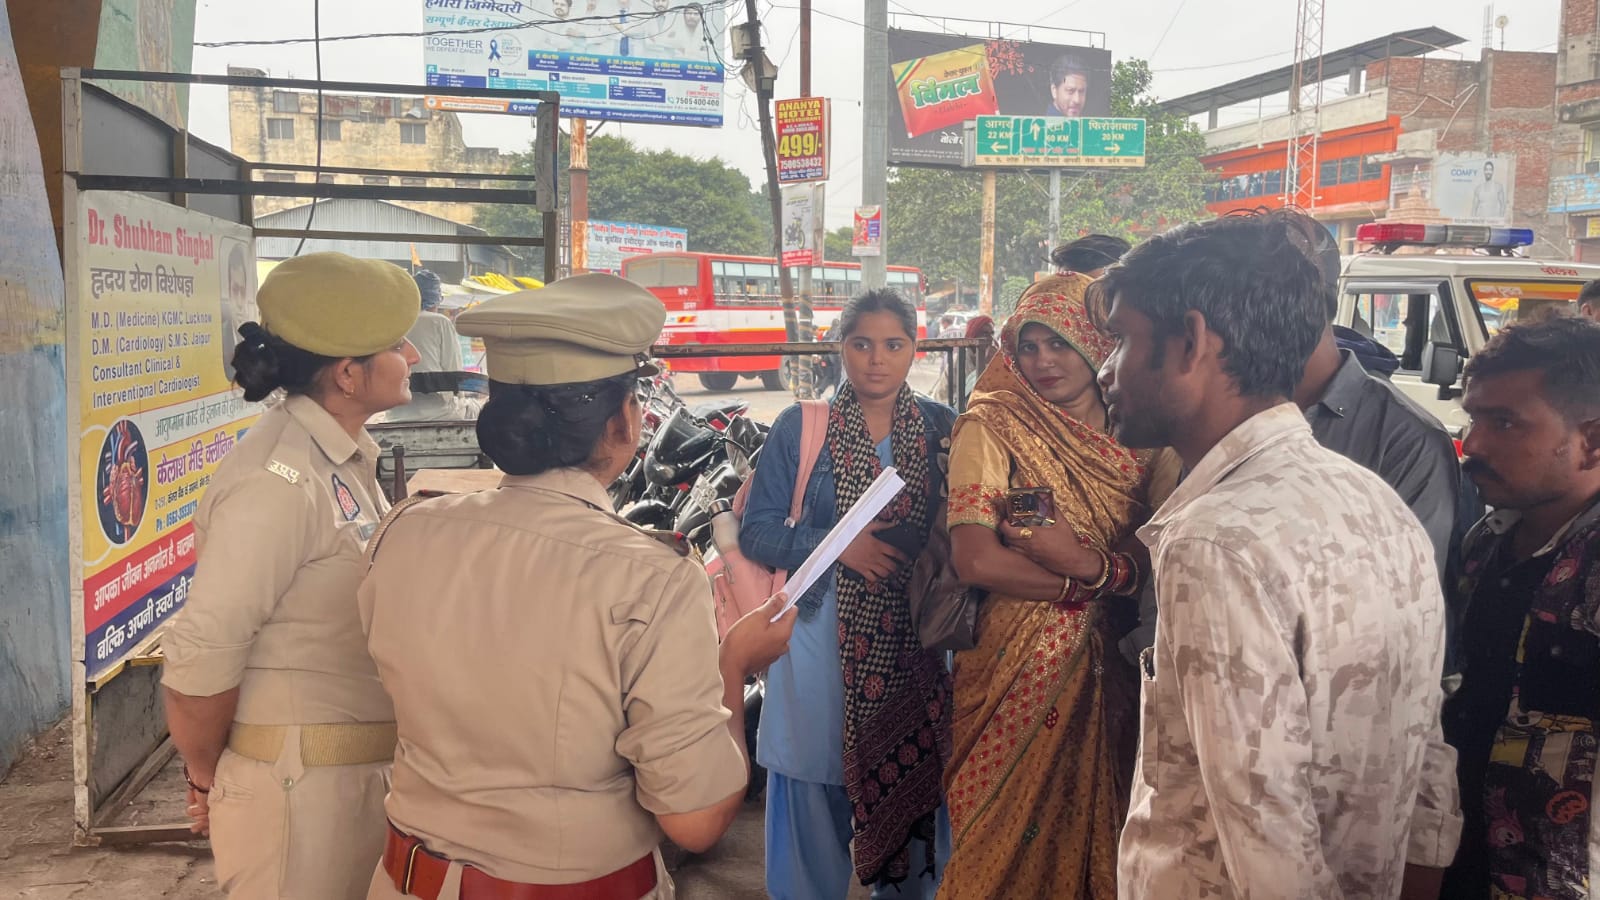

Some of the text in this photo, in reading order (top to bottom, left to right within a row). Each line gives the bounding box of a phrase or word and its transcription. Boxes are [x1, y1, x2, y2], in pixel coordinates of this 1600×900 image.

[426, 37, 483, 49] TOGETHER
[779, 100, 821, 111] ANANYA
[779, 108, 821, 119] HOTEL
[999, 131, 1012, 139] KM
[1057, 134, 1069, 143] KM
[1088, 120, 1138, 132] फिरोजाबाद
[1112, 133, 1124, 141] KM
[779, 132, 822, 158] 499/-
[1450, 168, 1478, 177] COMFY
[88, 208, 214, 266] Dr. Shubham Singhal
[129, 263, 152, 292] रोग
[155, 264, 194, 298] विशेषज्ञ
[92, 310, 212, 330] M.D. (Medicine) KGMC Lucknow
[92, 331, 211, 356] D.M. (Cardiology) S.M.S. Jaipur
[92, 354, 181, 382] Consultant Clinical &
[93, 374, 201, 408] Interventional Cardiologist
[155, 412, 185, 442] आयुष्मान
[157, 453, 187, 485] कैलाश
[206, 431, 234, 464] क्लीनिक
[94, 576, 121, 611] आपका
[121, 562, 143, 591] जीवन
[144, 545, 168, 579] अनमोल
[168, 538, 176, 566] है,
[97, 624, 126, 660] बल्कि
[127, 598, 154, 639] अपनी
[155, 583, 174, 618] स्वयं
[175, 575, 187, 603] की
